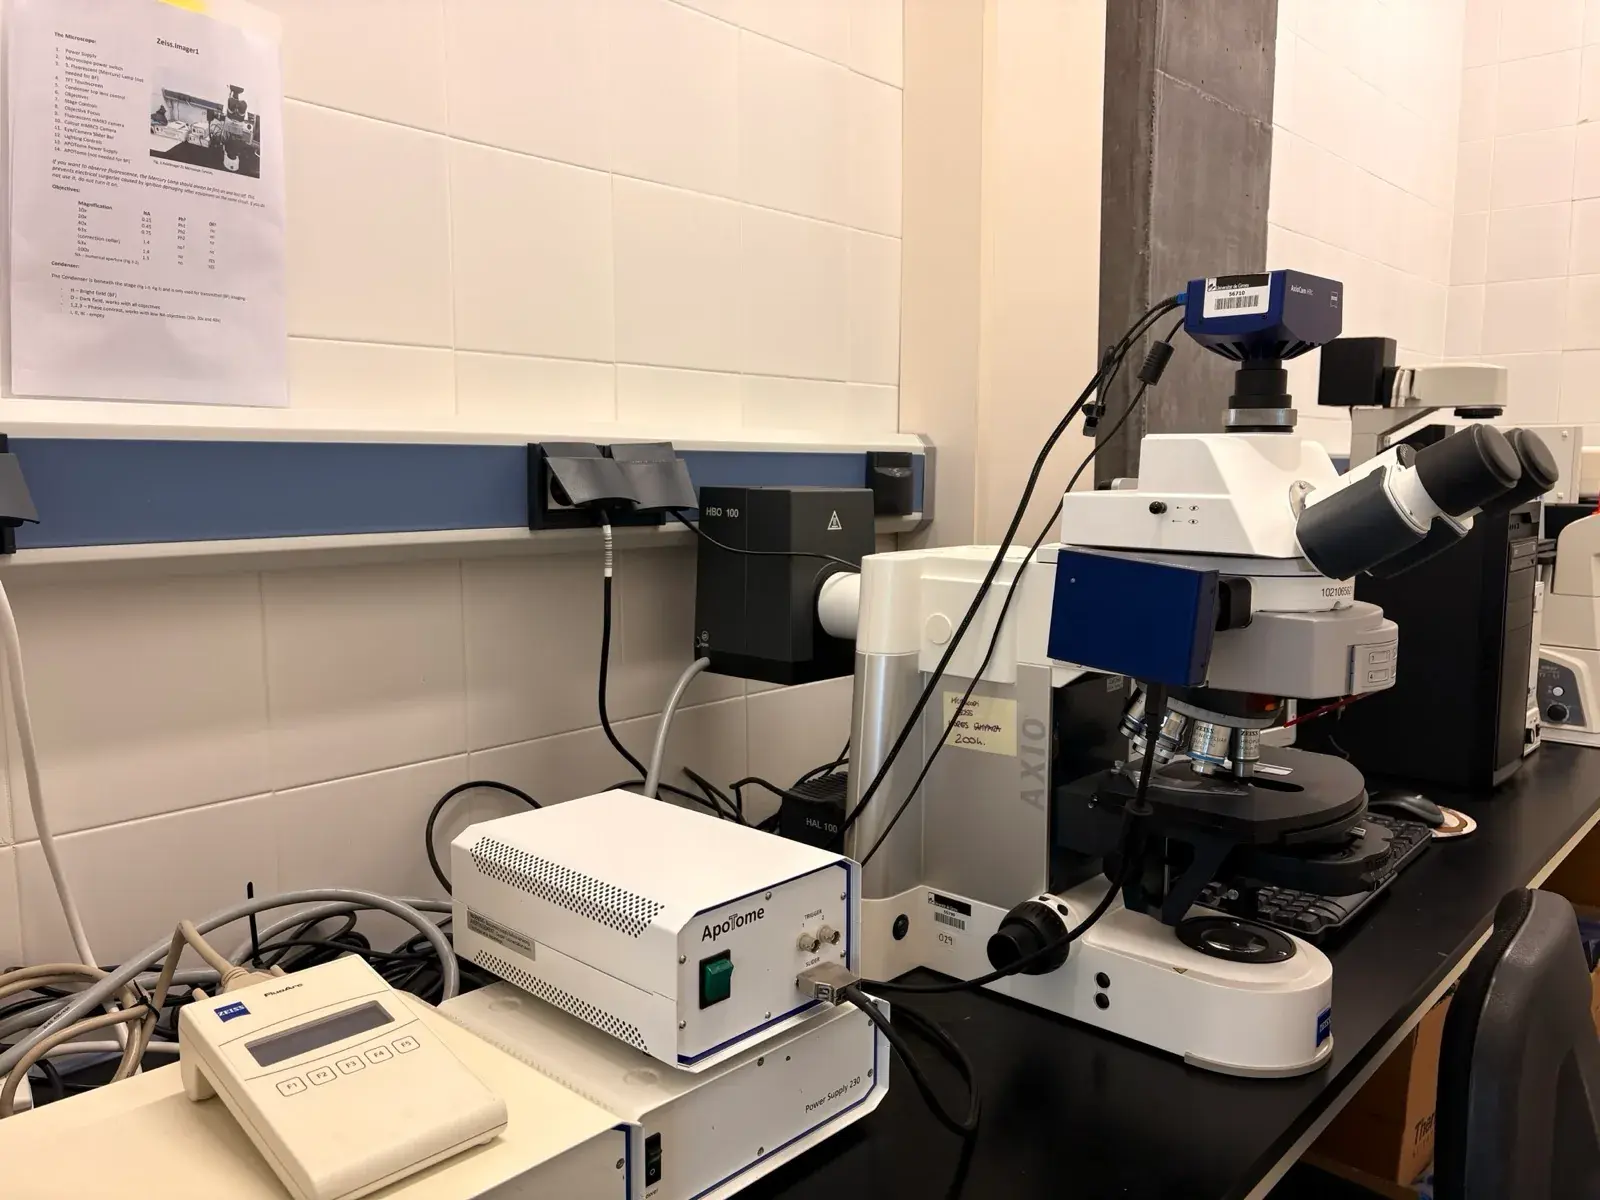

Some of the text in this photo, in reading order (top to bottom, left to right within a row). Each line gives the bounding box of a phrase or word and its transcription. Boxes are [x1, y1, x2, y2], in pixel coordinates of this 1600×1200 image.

[706, 507, 739, 518] HBO 100
[1020, 718, 1046, 811] AXIO
[806, 818, 838, 833] HAL 100
[702, 908, 765, 942] ApoTome
[218, 1005, 244, 1016] ZEISS
[805, 1076, 861, 1113] Power Supply 230
